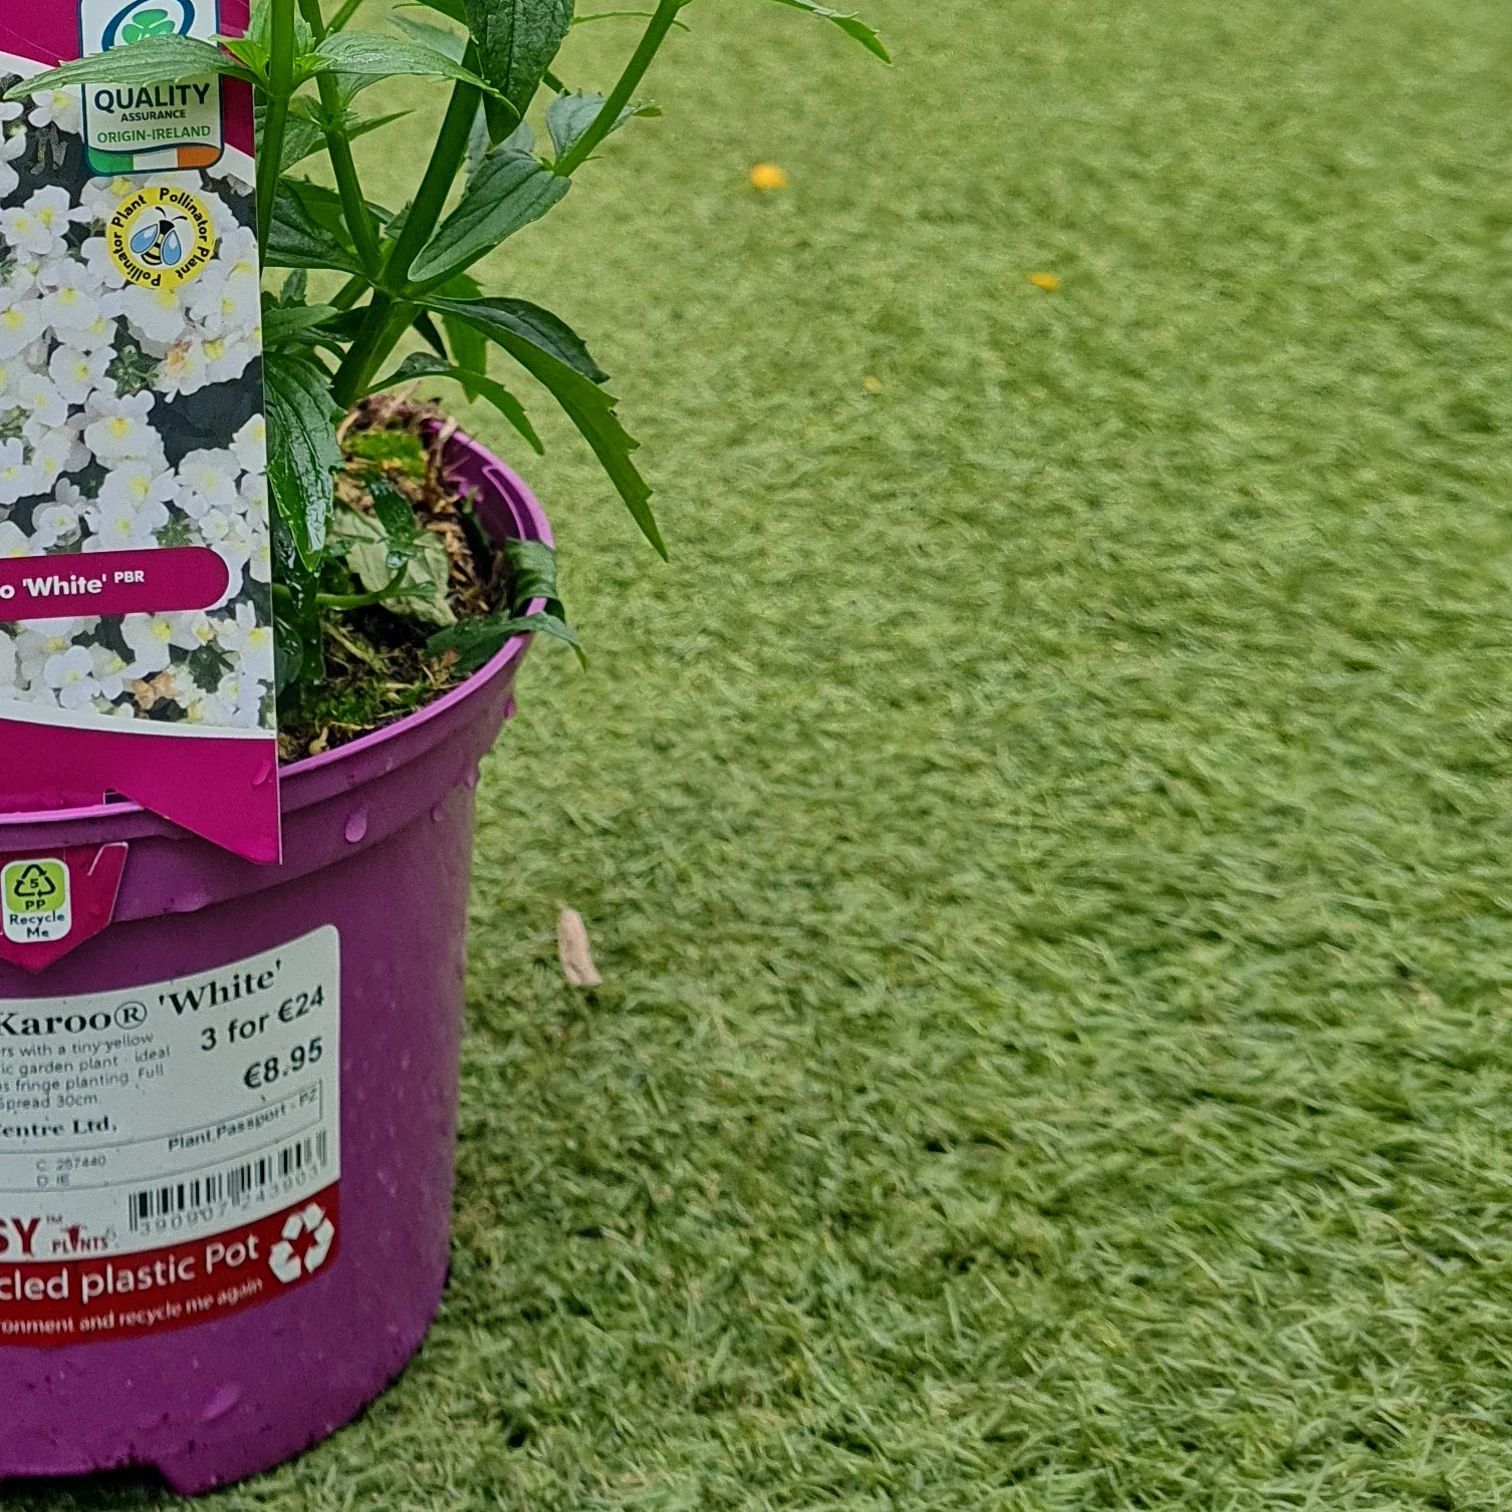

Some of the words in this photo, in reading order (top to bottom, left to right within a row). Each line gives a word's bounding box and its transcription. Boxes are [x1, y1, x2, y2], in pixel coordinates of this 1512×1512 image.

[94, 83, 210, 114] QUALITY
[121, 109, 186, 123] ASSURANCE
[97, 125, 211, 143] ORIGIN-IRELAND
[111, 194, 148, 228] Plant
[159, 187, 208, 242] Pollinator
[112, 232, 162, 287] Pollinator
[175, 246, 210, 280] Plant
[22, 573, 107, 598] 'White'
[113, 570, 145, 584] PBR
[9, 910, 66, 926] Recycle
[24, 899, 46, 911] PP
[26, 927, 50, 939] Me
[158, 958, 282, 1016] 'White'
[201, 1027, 217, 1052] 3
[228, 1013, 270, 1043] for
[277, 984, 325, 1024] €24
[18, 1060, 74, 1079] garden
[79, 1056, 119, 1073] plant
[134, 1045, 171, 1064] ideal
[19, 1043, 53, 1057] with
[57, 1047, 66, 1055] a
[243, 1037, 323, 1089] €8.95
[15, 1078, 61, 1096] fringe
[80, 1253, 197, 1305] plastic
[205, 1233, 260, 1276] Pot
[78, 1309, 116, 1333] and
[118, 1299, 183, 1327] recycle
[184, 1293, 215, 1315] me
[216, 1276, 265, 1306] again
